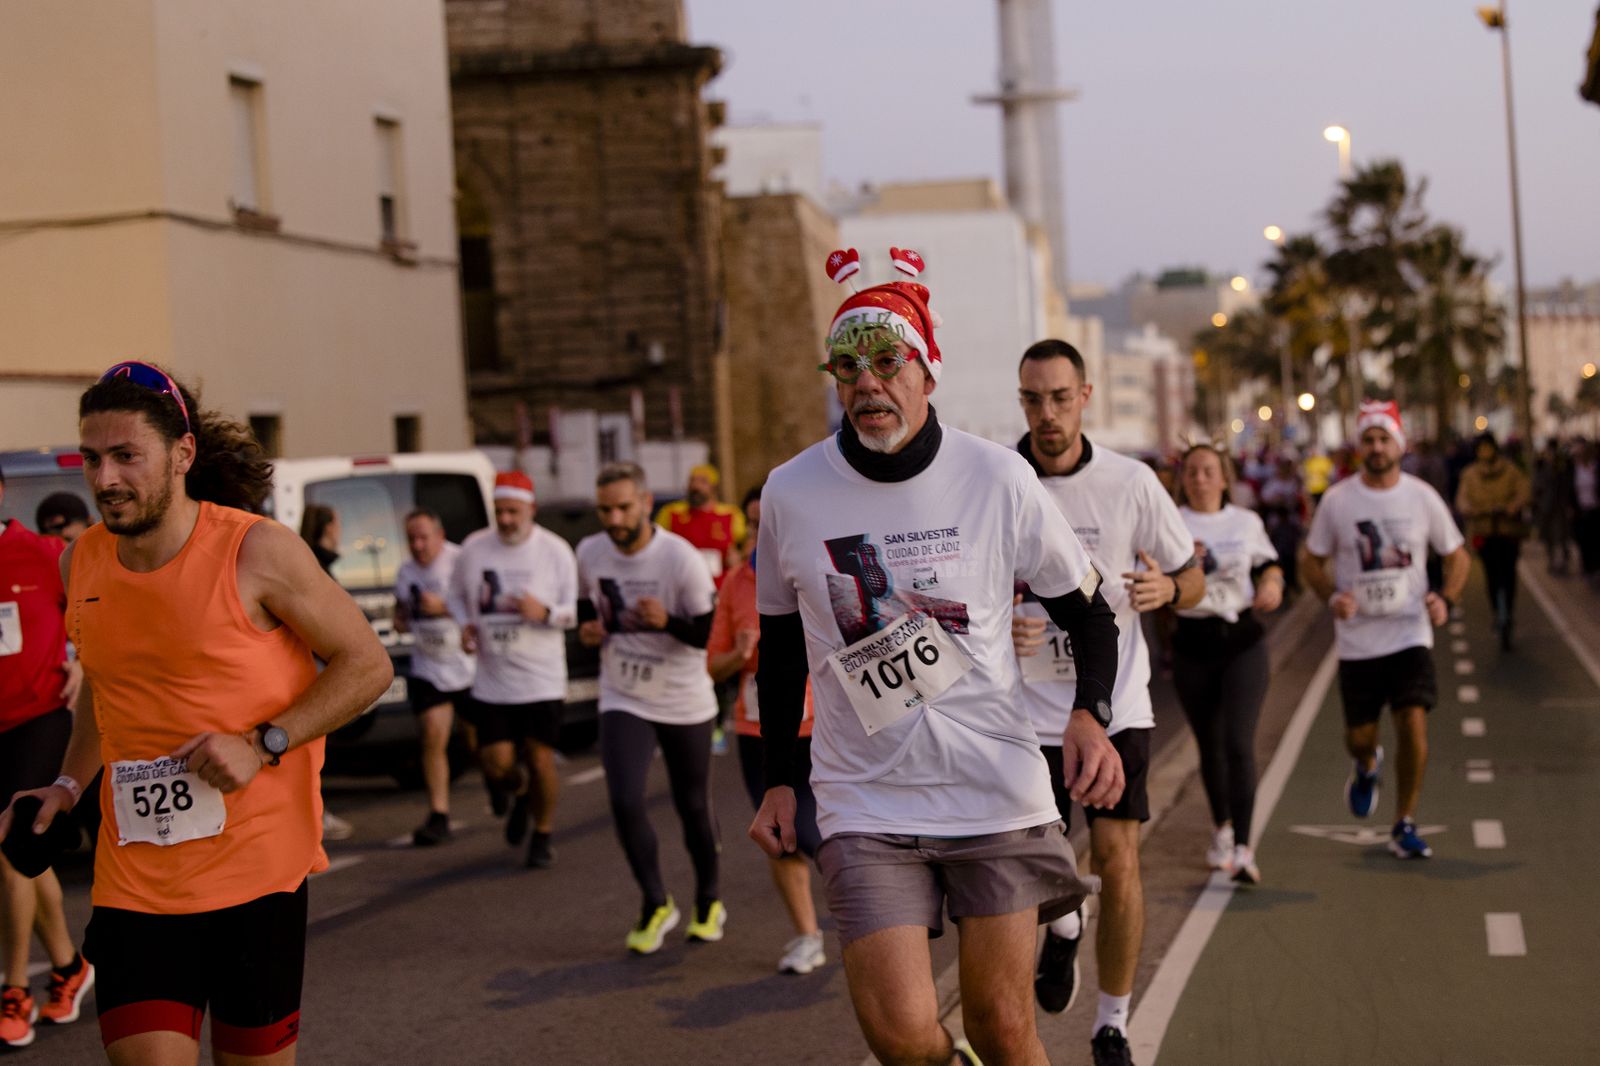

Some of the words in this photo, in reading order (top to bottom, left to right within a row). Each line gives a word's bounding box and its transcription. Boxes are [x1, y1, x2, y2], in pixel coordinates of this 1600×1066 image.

[884, 533, 906, 545] SAN
[908, 527, 959, 543] SILVESTRE
[886, 546, 919, 560] CIUDAD
[922, 545, 933, 556] DE
[935, 541, 960, 554] CÁDIZ
[840, 647, 862, 665] SAN
[844, 649, 881, 673] CIUDAD
[879, 643, 896, 658] DE
[860, 636, 939, 699] 1076
[116, 766, 135, 774] SAN
[136, 758, 188, 771] SILVEST
[116, 771, 149, 784] CIUDAD
[153, 769, 168, 780] DE
[132, 779, 193, 817] 528
